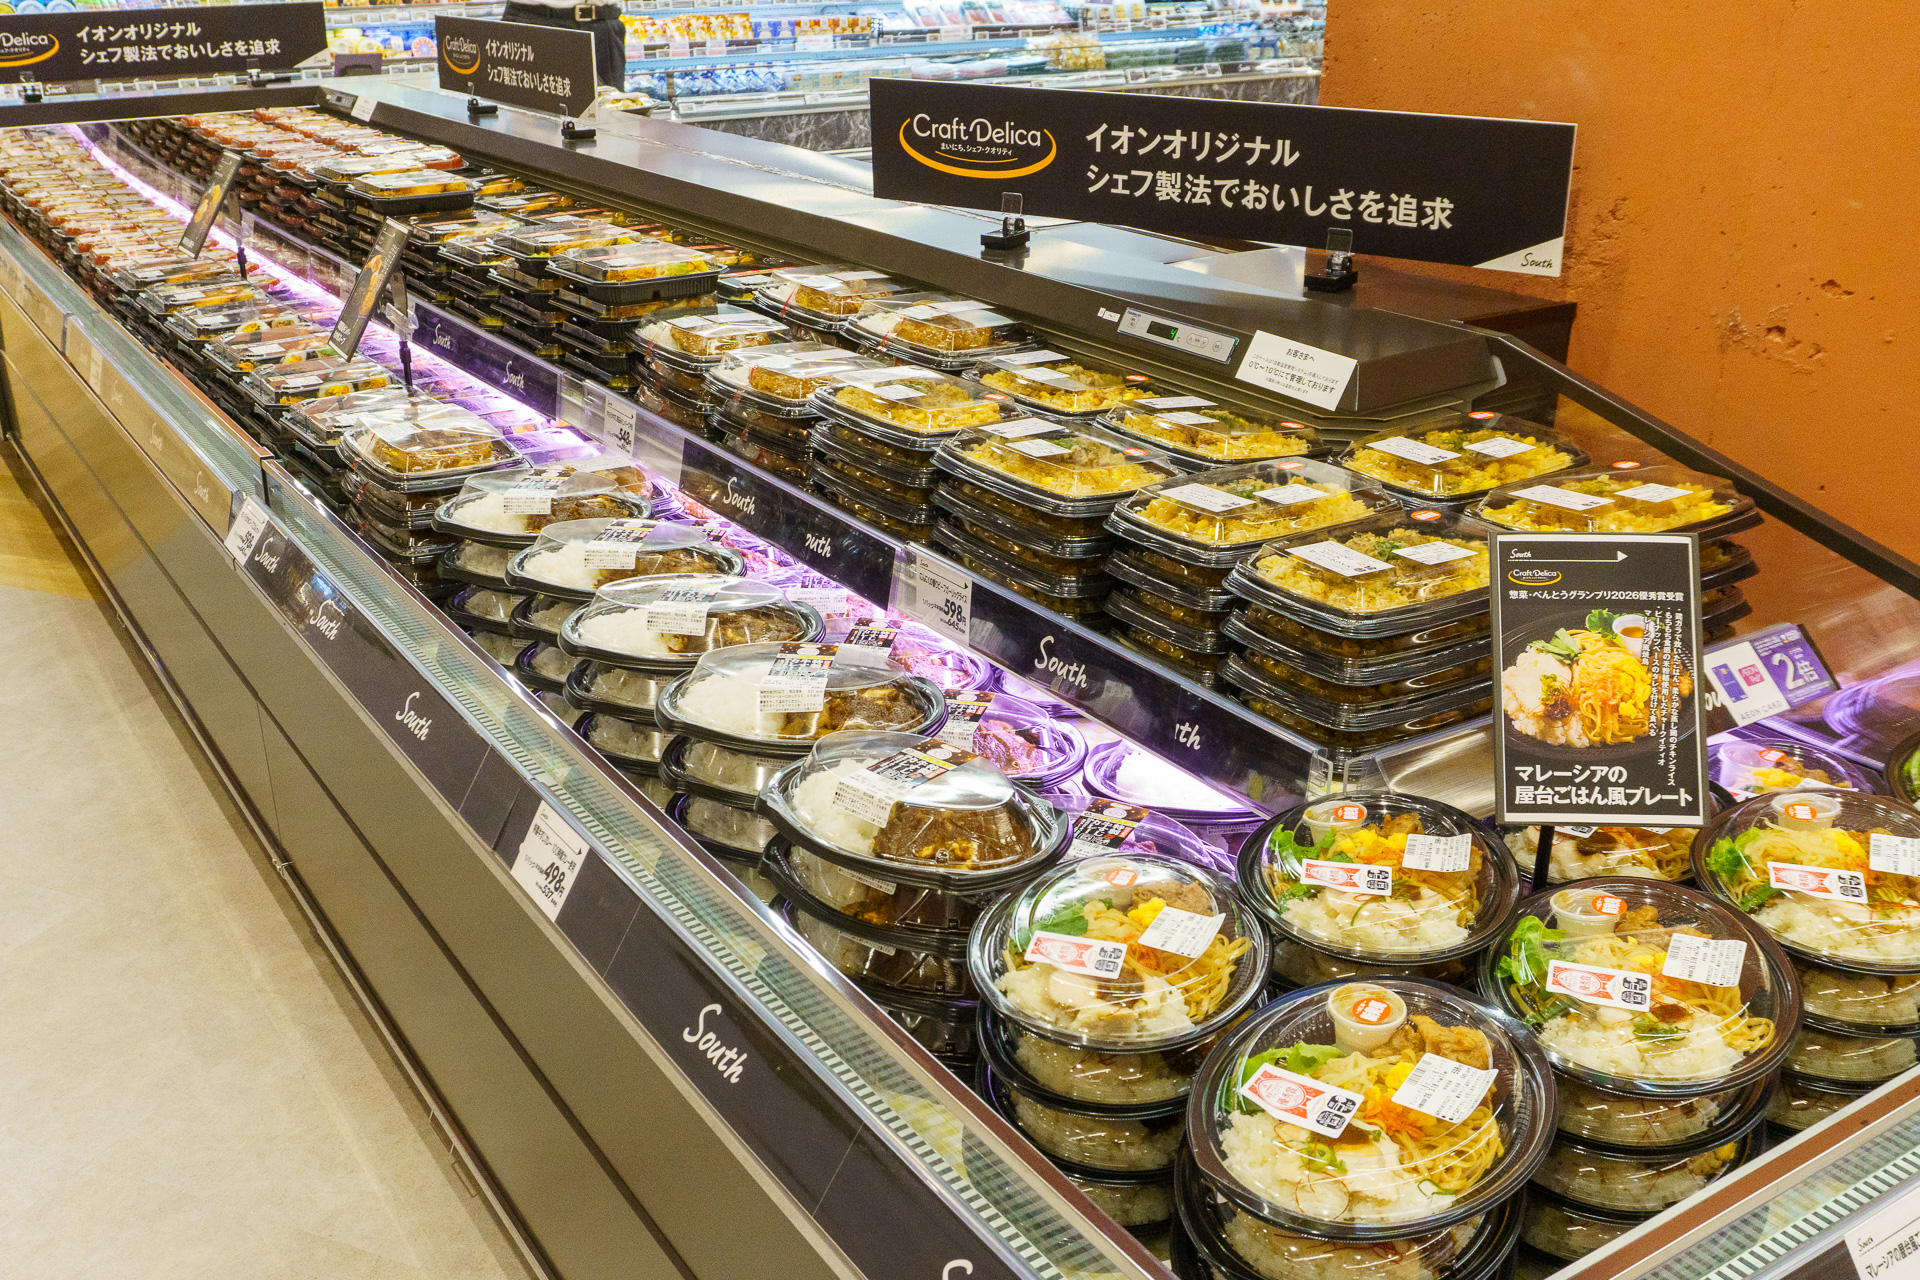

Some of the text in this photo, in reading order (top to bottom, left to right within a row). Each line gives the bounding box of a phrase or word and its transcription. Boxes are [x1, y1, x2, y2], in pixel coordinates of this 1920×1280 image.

[1, 33, 48, 47] Delica
[76, 21, 201, 44] イオンオリジナル
[80, 39, 281, 65] シェフ製法でおいしさを追求
[485, 39, 535, 62] イオンオリジナル
[487, 64, 572, 97] シェフ製法でおいしさを追求
[913, 113, 1041, 147] Craft Delica
[940, 142, 1013, 156] まいにち、シェフ・クオリティ
[1086, 122, 1300, 167] イオンオリジナル
[1086, 165, 1454, 230] シェフ製法でおいしさを追求
[1521, 252, 1553, 269] South
[433, 324, 450, 350] South
[1285, 348, 1315, 362] お客さまへ
[503, 361, 524, 389] South
[723, 476, 755, 515] South
[254, 537, 281, 574] South
[1510, 549, 1531, 559] South
[1513, 569, 1557, 577] Craft Delica
[1509, 590, 1684, 602] 惣菜・べんとうグランプリ2026優秀賞受賞
[310, 599, 341, 641] South
[1034, 635, 1087, 688] South
[1771, 653, 1820, 692] 2倍
[395, 691, 432, 741] South
[1740, 700, 1783, 721] AEON CARD
[1514, 764, 1628, 783] マレーシアの
[1514, 785, 1693, 807] 屋台ごはん風プレート
[683, 1003, 747, 1084] South
